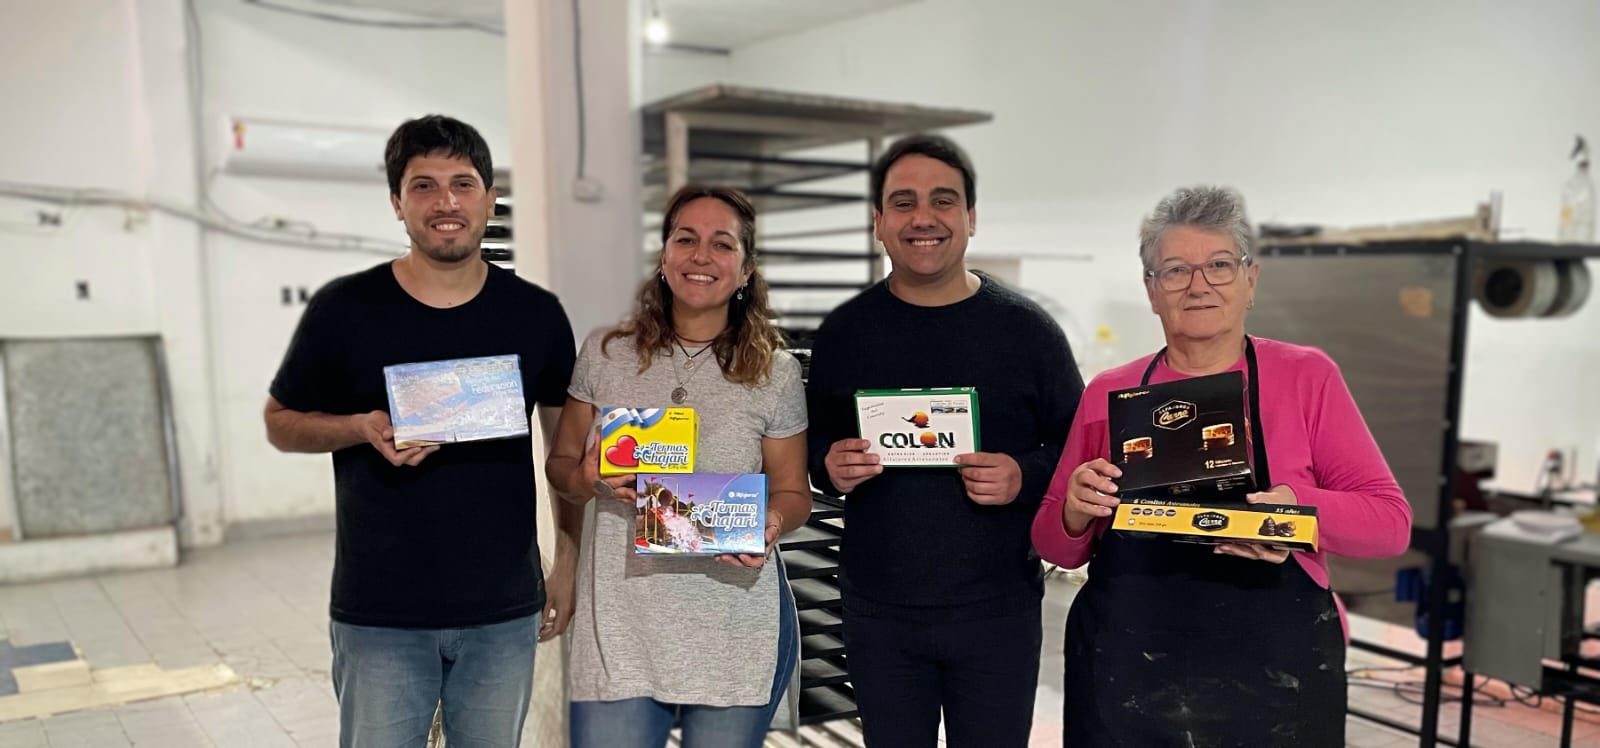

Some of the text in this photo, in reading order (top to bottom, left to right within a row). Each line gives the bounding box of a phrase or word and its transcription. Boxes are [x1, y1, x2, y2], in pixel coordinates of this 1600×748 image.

[879, 431, 955, 449] COLON
[650, 442, 689, 452] Termas
[1204, 459, 1215, 470] 12
[710, 500, 757, 513] Termas
